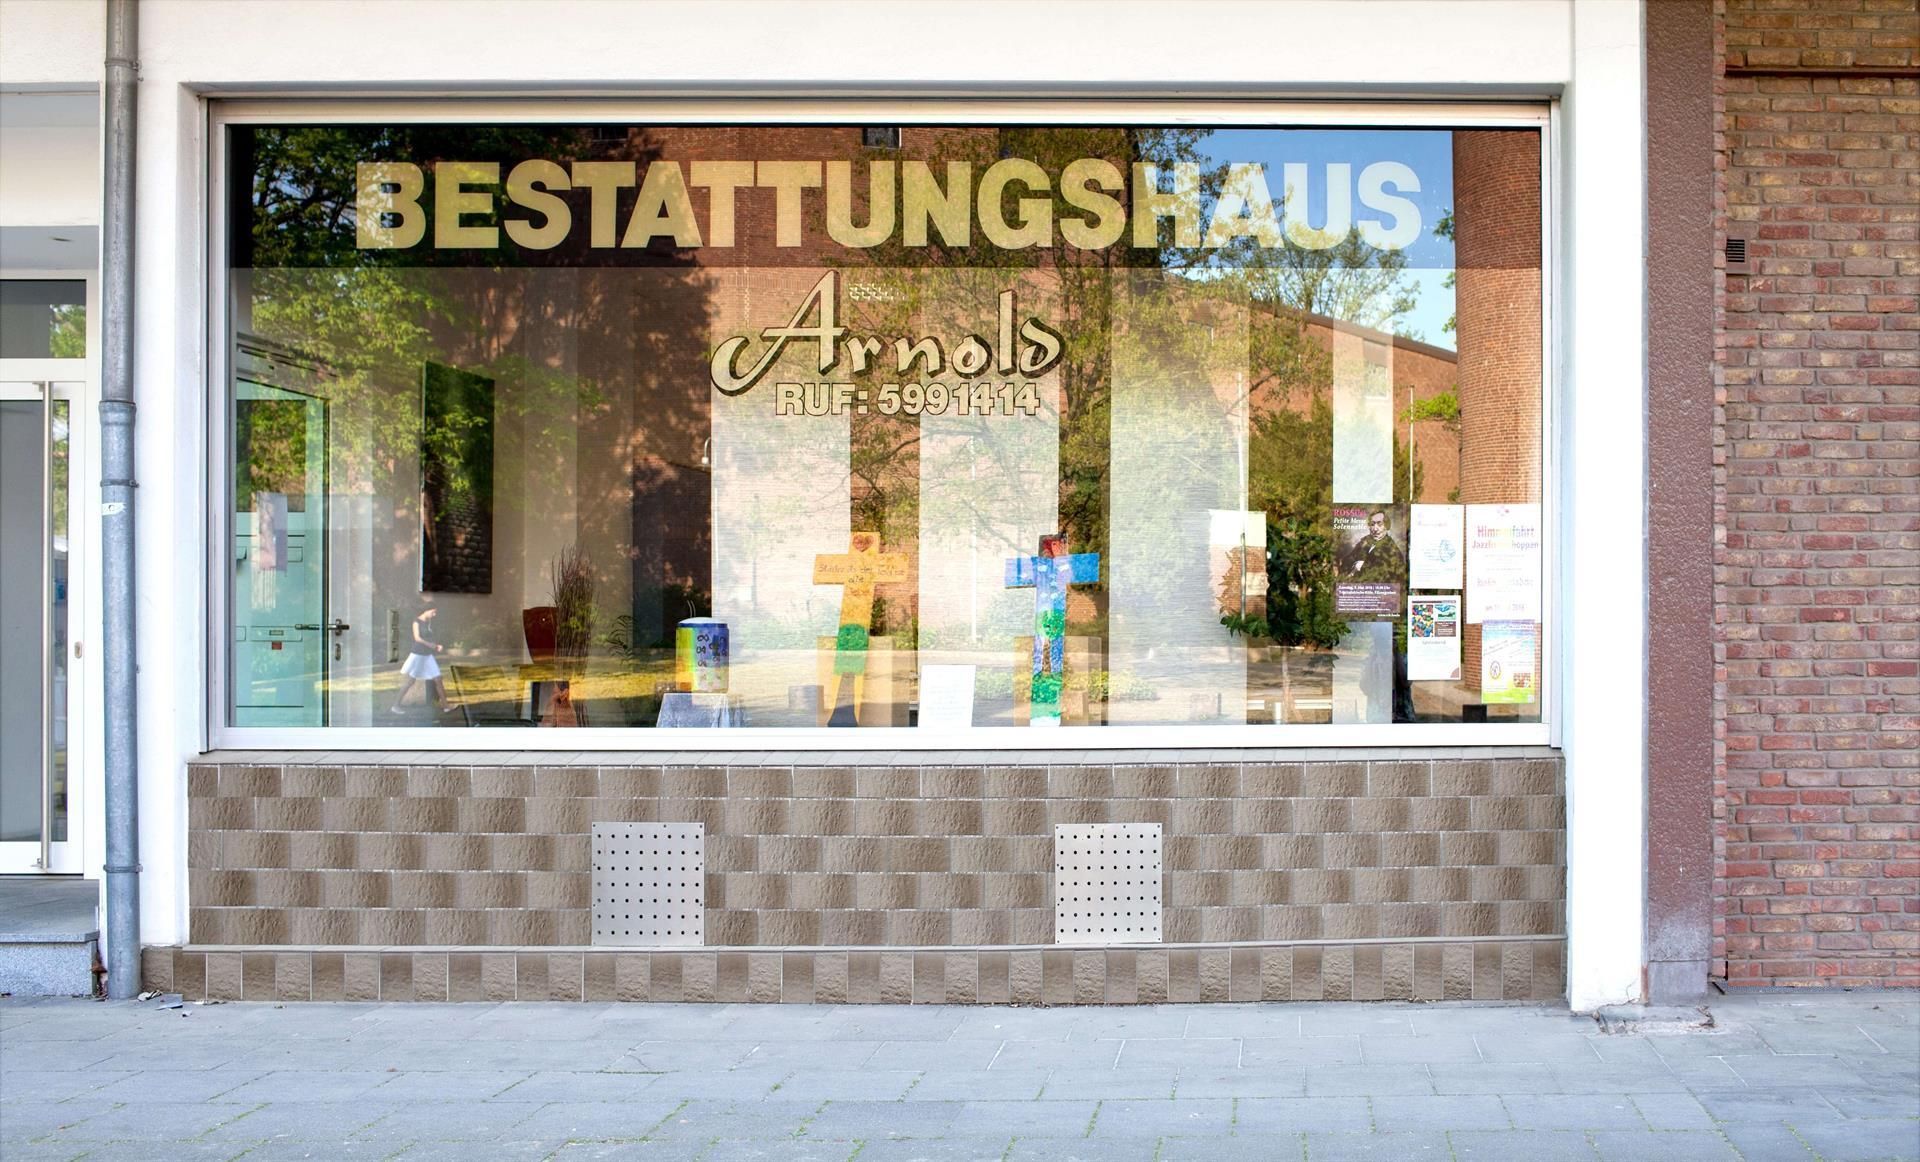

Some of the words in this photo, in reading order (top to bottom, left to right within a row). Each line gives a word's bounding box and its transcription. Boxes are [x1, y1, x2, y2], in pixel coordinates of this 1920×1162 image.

[355, 158, 1423, 251] BESTATTUNGSHAUS
[711, 269, 1066, 396] Arnold
[775, 382, 868, 416] RUF:
[877, 382, 1041, 416] 5991414
[1477, 525, 1535, 537] Himfahrt
